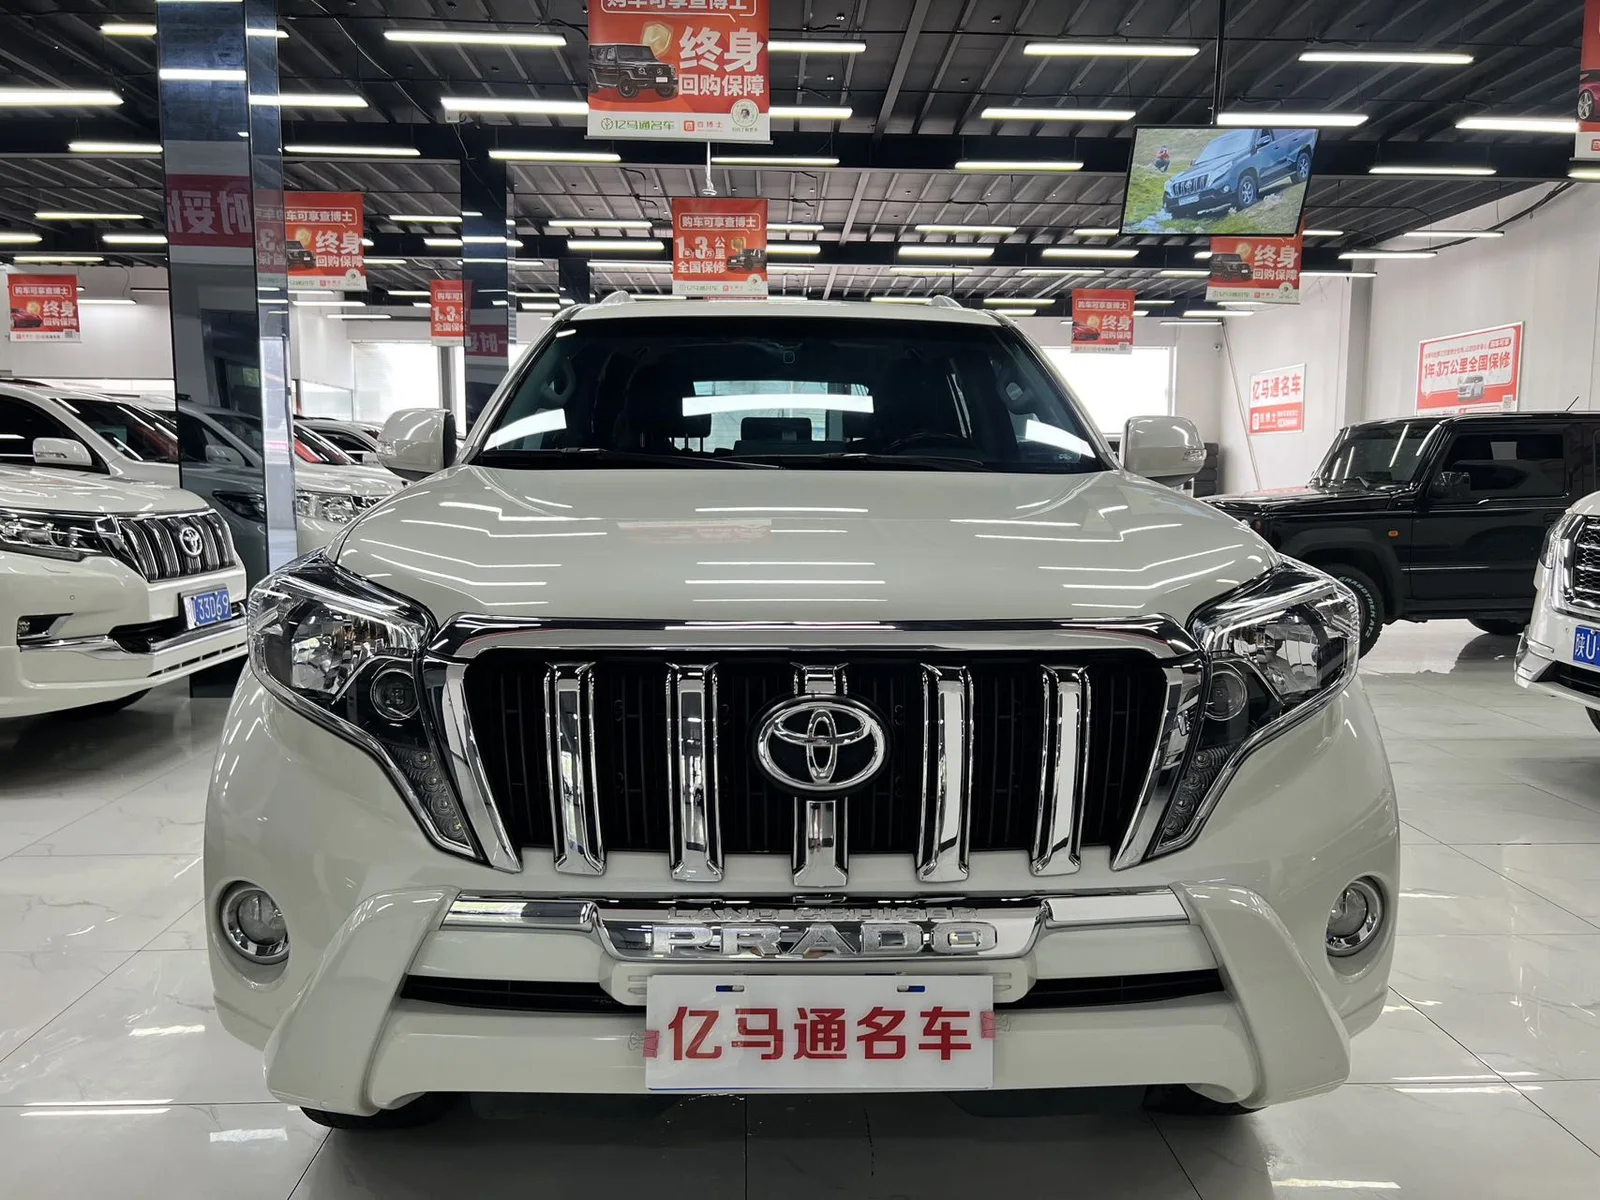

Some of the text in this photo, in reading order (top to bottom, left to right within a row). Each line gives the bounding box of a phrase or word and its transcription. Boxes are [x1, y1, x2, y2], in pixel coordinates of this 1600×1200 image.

[678, 25, 764, 72] 终身
[678, 74, 765, 97] 回购保障
[682, 216, 756, 228] 购车可享查博士
[315, 230, 362, 255] 终身
[315, 255, 363, 268] 回购保障
[677, 260, 726, 274] 全国保修
[1254, 244, 1299, 268] 终身
[1252, 268, 1298, 280] 回购保障
[42, 300, 76, 317] 终身
[1101, 315, 1132, 331] 终身
[1252, 373, 1301, 401] 亿马通名车
[652, 923, 998, 955] PRADO
[668, 1006, 972, 1061] 亿马通名车
